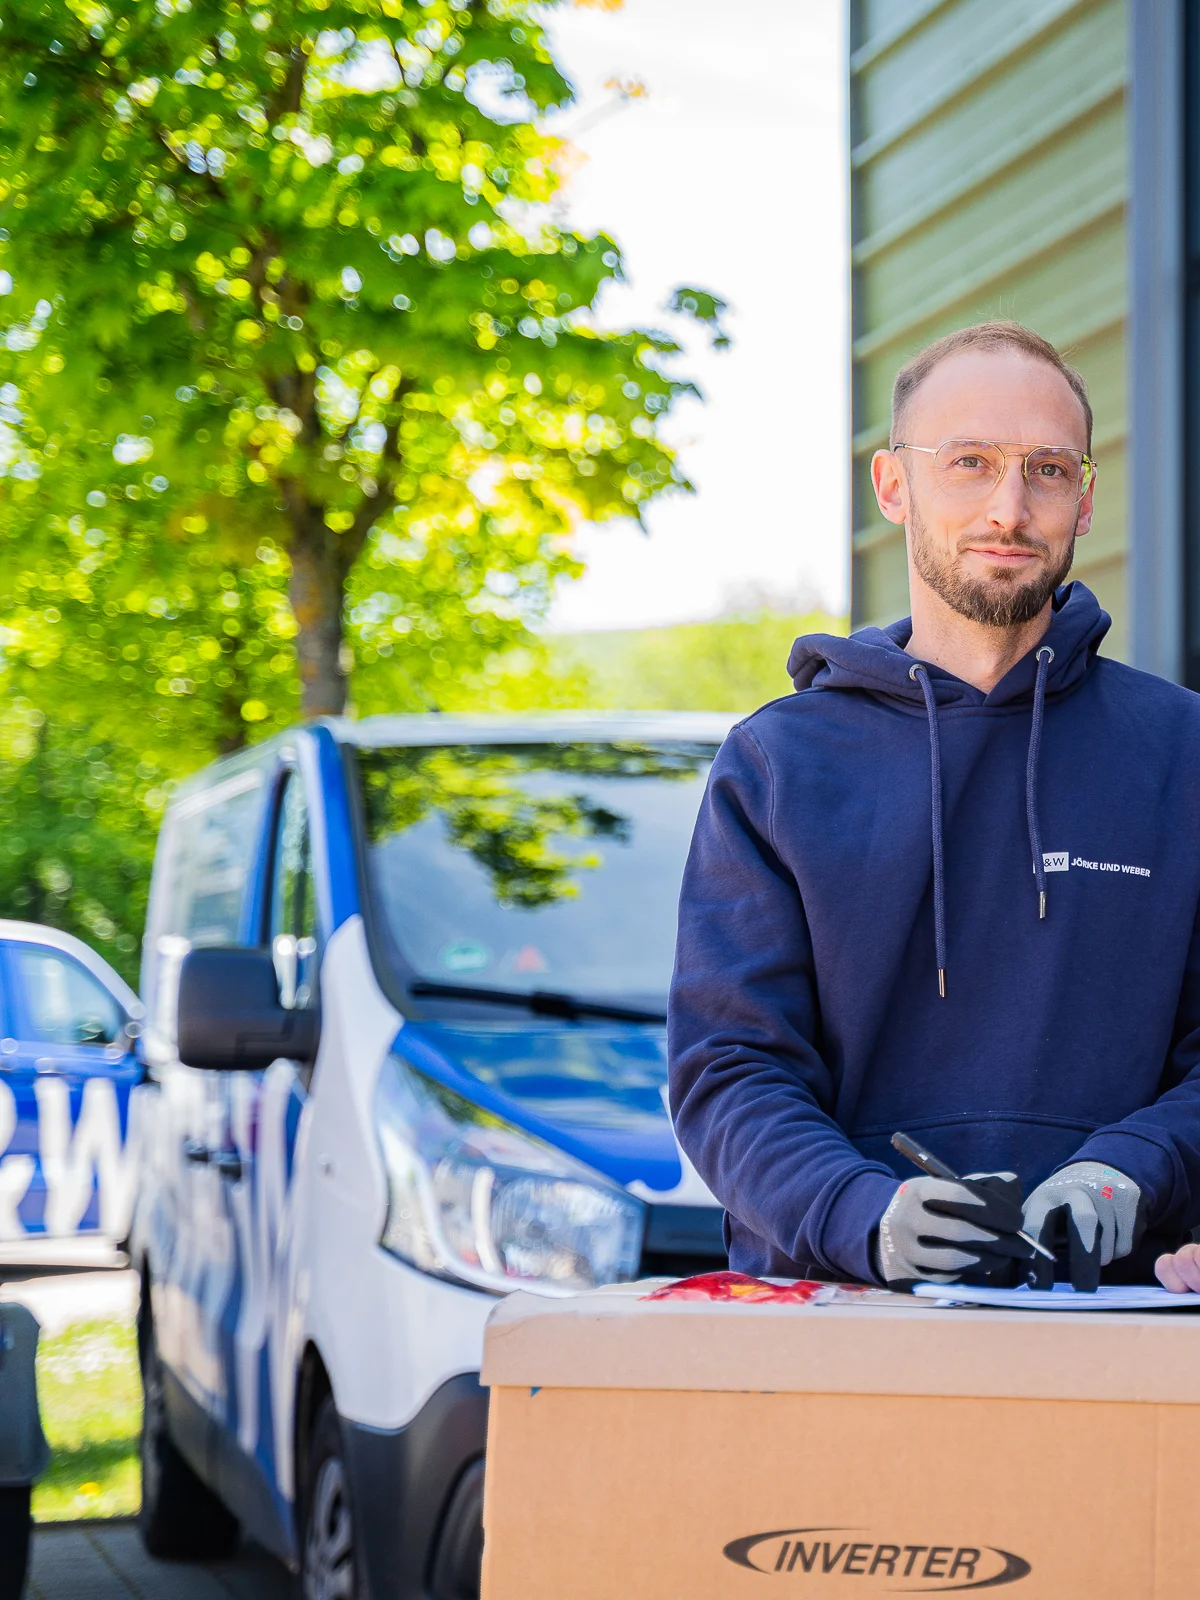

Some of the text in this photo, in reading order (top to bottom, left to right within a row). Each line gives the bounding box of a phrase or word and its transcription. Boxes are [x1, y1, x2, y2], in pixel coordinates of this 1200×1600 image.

[1071, 857, 1098, 870] JÖRKE
[1100, 862, 1120, 872] UND
[1121, 864, 1151, 877] WEBER
[774, 1541, 982, 1580] INVERTER
